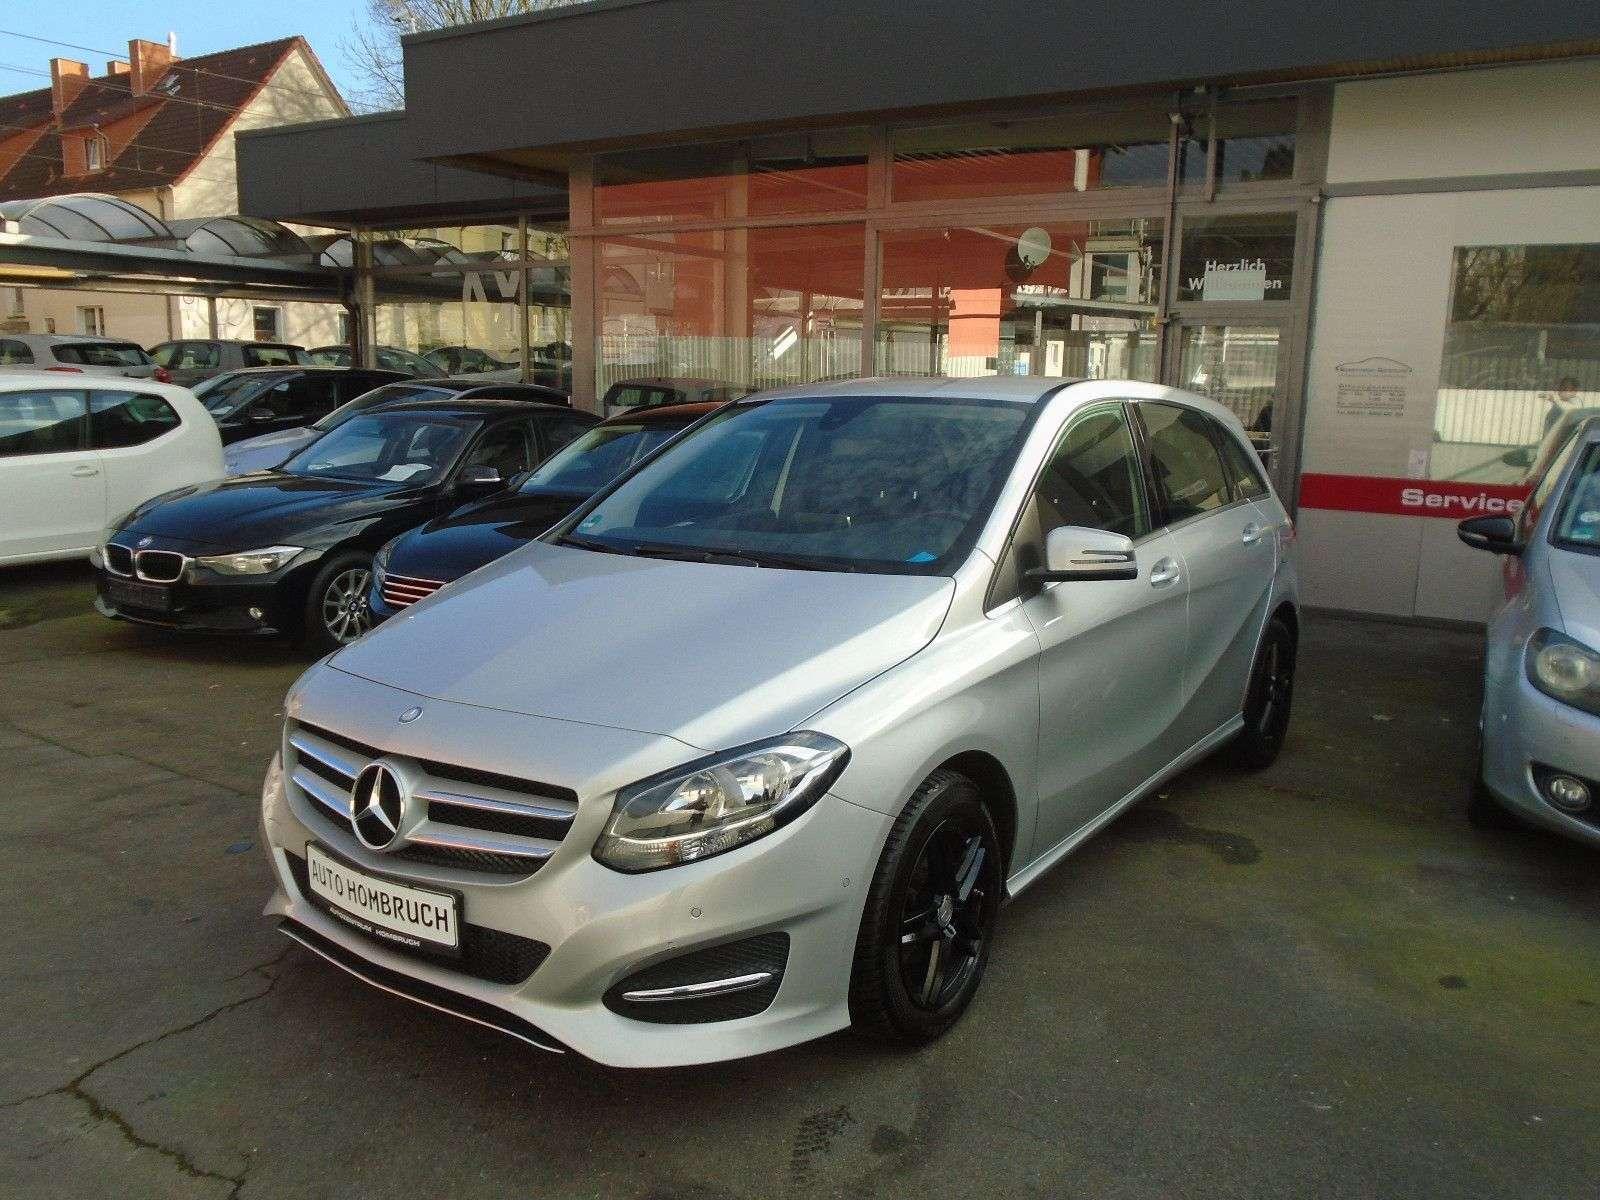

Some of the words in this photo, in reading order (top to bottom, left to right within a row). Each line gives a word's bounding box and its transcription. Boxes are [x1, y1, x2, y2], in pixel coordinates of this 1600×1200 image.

[1205, 258, 1266, 272] Herzlich
[1401, 487, 1525, 513] Service
[312, 858, 344, 896] AUTO
[347, 879, 449, 933] HOMBRUCH
